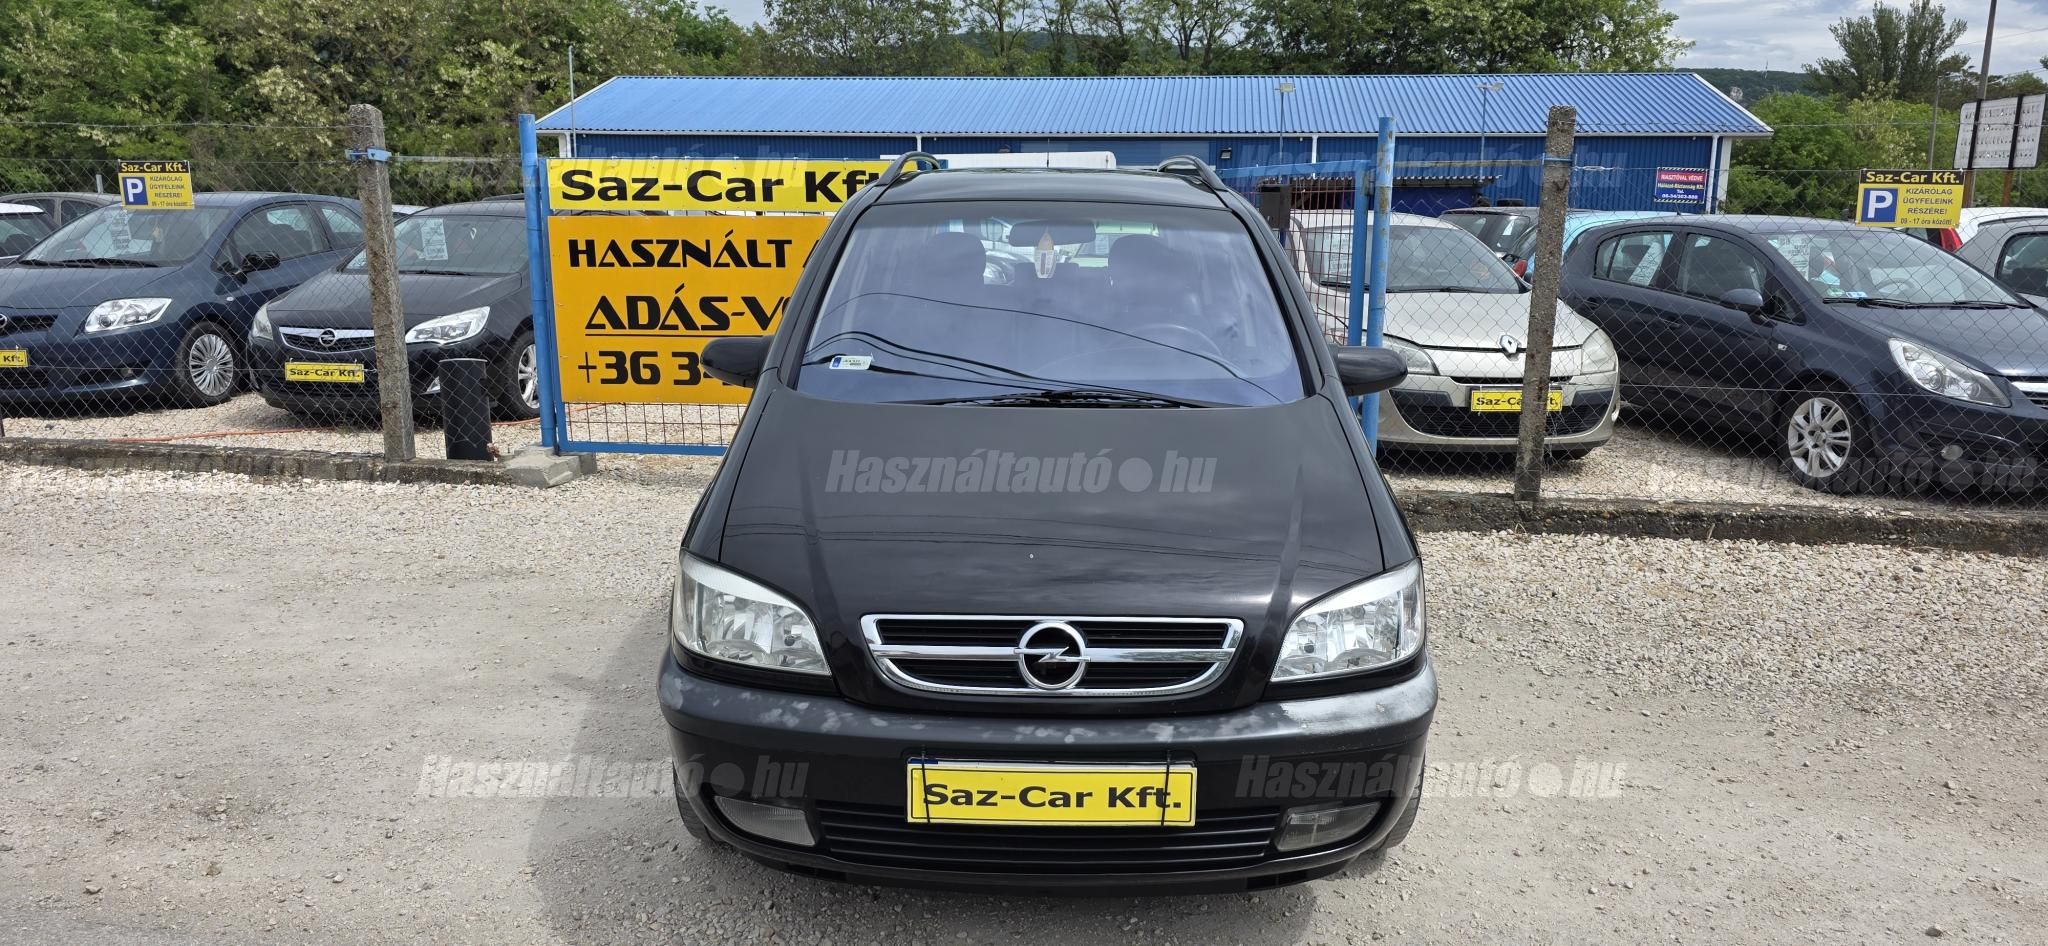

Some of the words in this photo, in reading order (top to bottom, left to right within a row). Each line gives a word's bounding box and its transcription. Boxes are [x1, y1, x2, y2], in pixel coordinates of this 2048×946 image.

[121, 163, 162, 172] Saz-Car
[166, 163, 186, 172] Kft.
[1866, 171, 1927, 183] Saz-Car
[1932, 172, 1960, 183] Kft.
[126, 178, 143, 202] P
[561, 169, 784, 203] Saz-Car
[1867, 190, 1893, 218] P
[568, 229, 792, 268] HASZNÁLT
[585, 283, 790, 331] ADÁS-V
[289, 368, 335, 377] Saz-Car
[339, 369, 360, 378] Kft.
[578, 350, 661, 385] +36
[924, 783, 1093, 808] Saz-Car
[1107, 786, 1182, 808] Kft.
